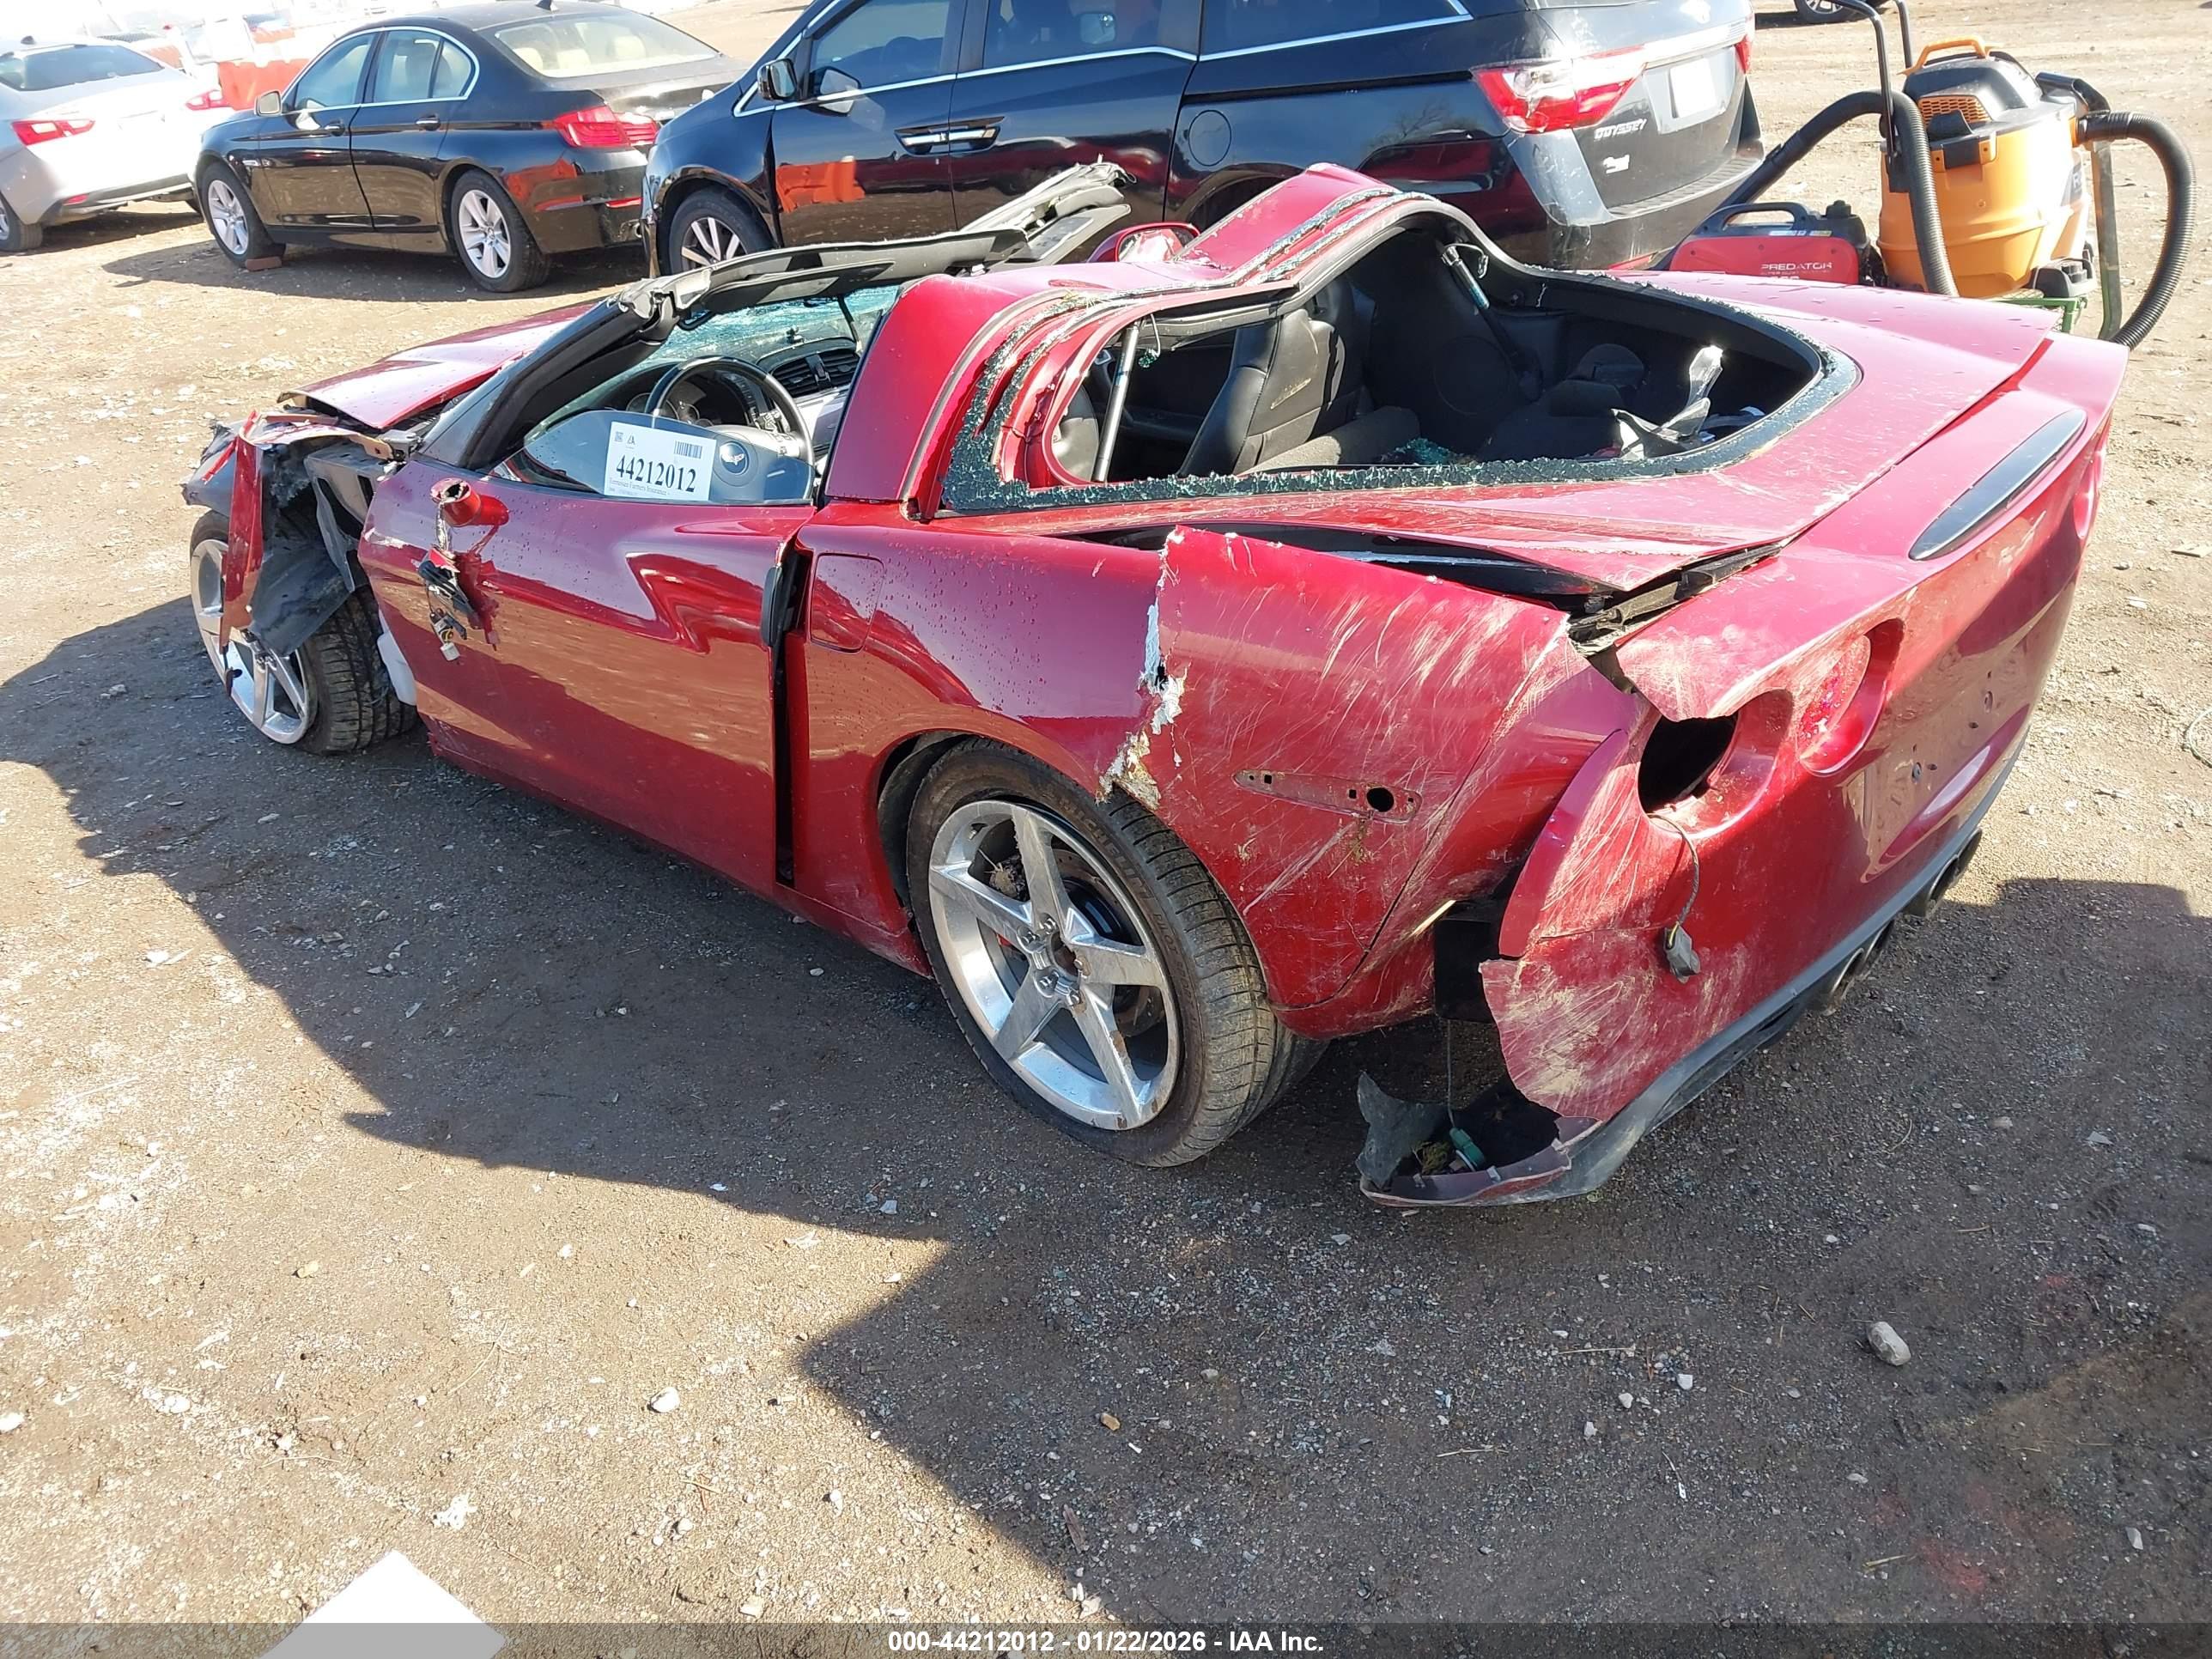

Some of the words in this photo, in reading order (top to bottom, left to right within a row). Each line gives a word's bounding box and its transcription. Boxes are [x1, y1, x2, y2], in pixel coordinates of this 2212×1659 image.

[1595, 118, 1648, 139] ODYSSEY
[1761, 262, 1832, 270] PREDATOR
[617, 454, 696, 492] 44212012
